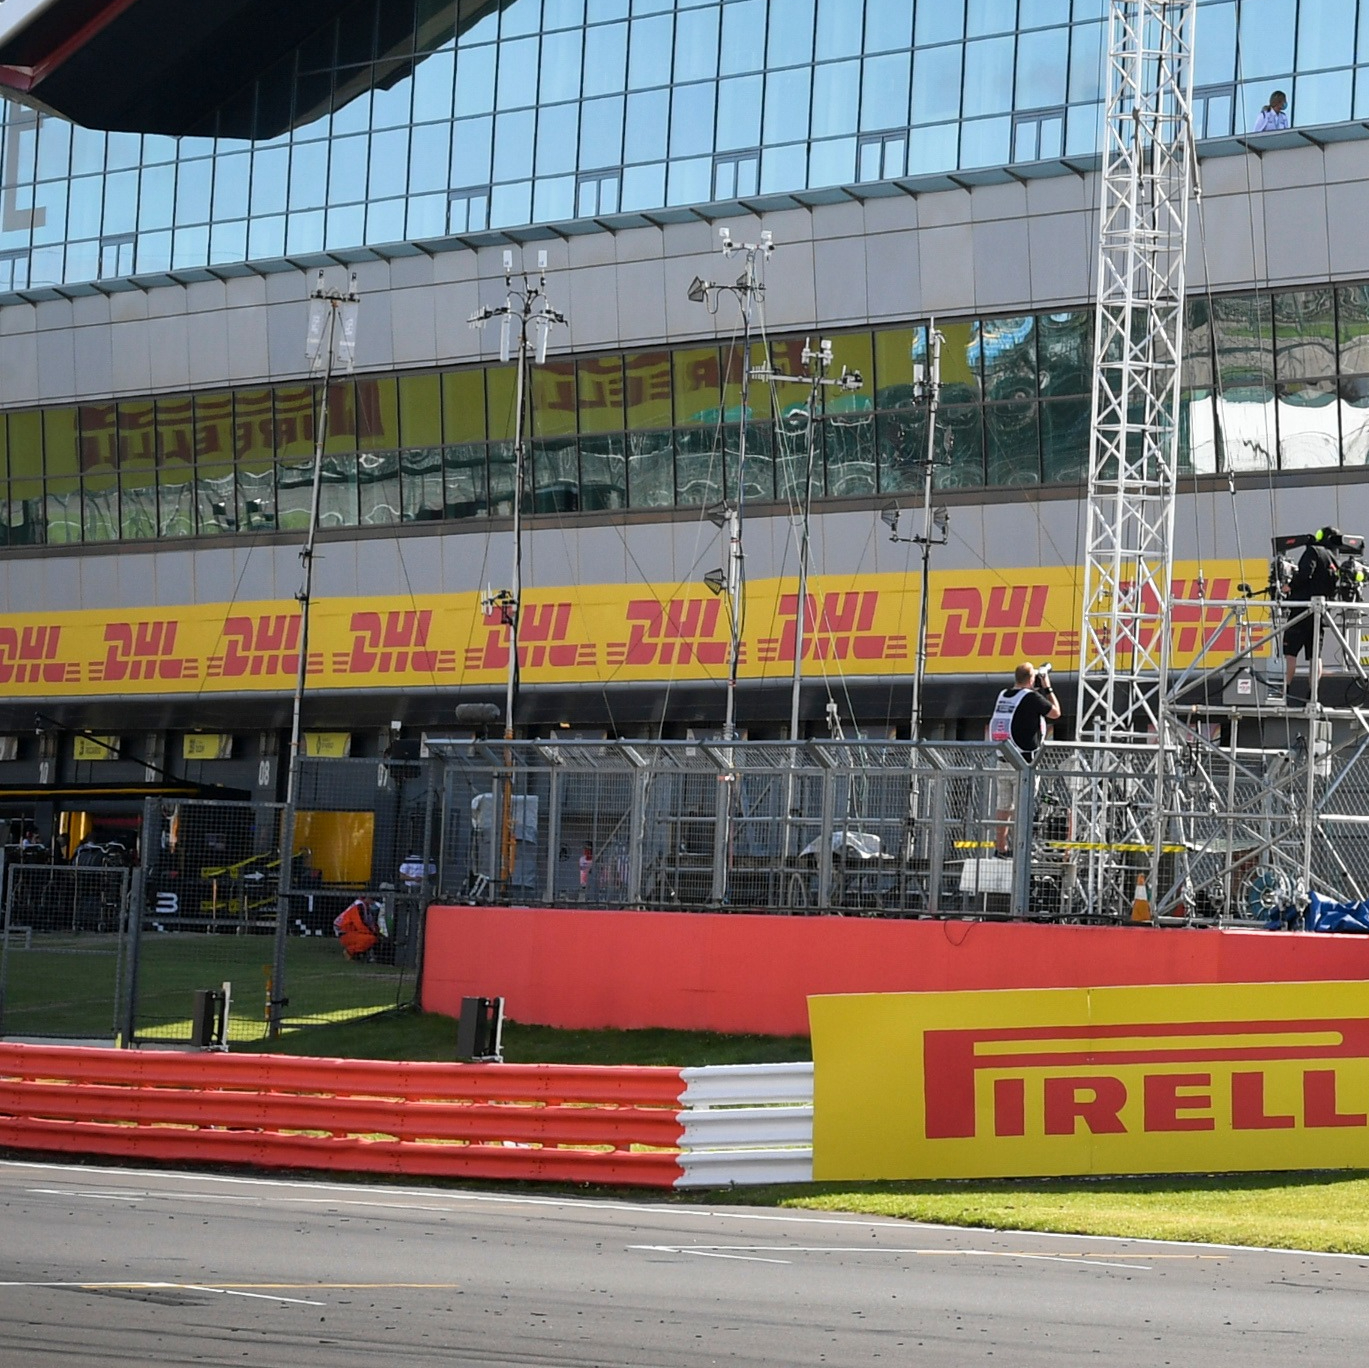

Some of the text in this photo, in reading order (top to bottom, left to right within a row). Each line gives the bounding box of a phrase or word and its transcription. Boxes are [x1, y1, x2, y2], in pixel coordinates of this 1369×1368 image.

[104, 621, 182, 680] DHL
[222, 615, 308, 676] DHL
[350, 611, 438, 672] DHL
[483, 603, 578, 670] DHL
[626, 599, 727, 665] DHL
[779, 592, 886, 661] DHL
[941, 586, 1056, 656] DHL
